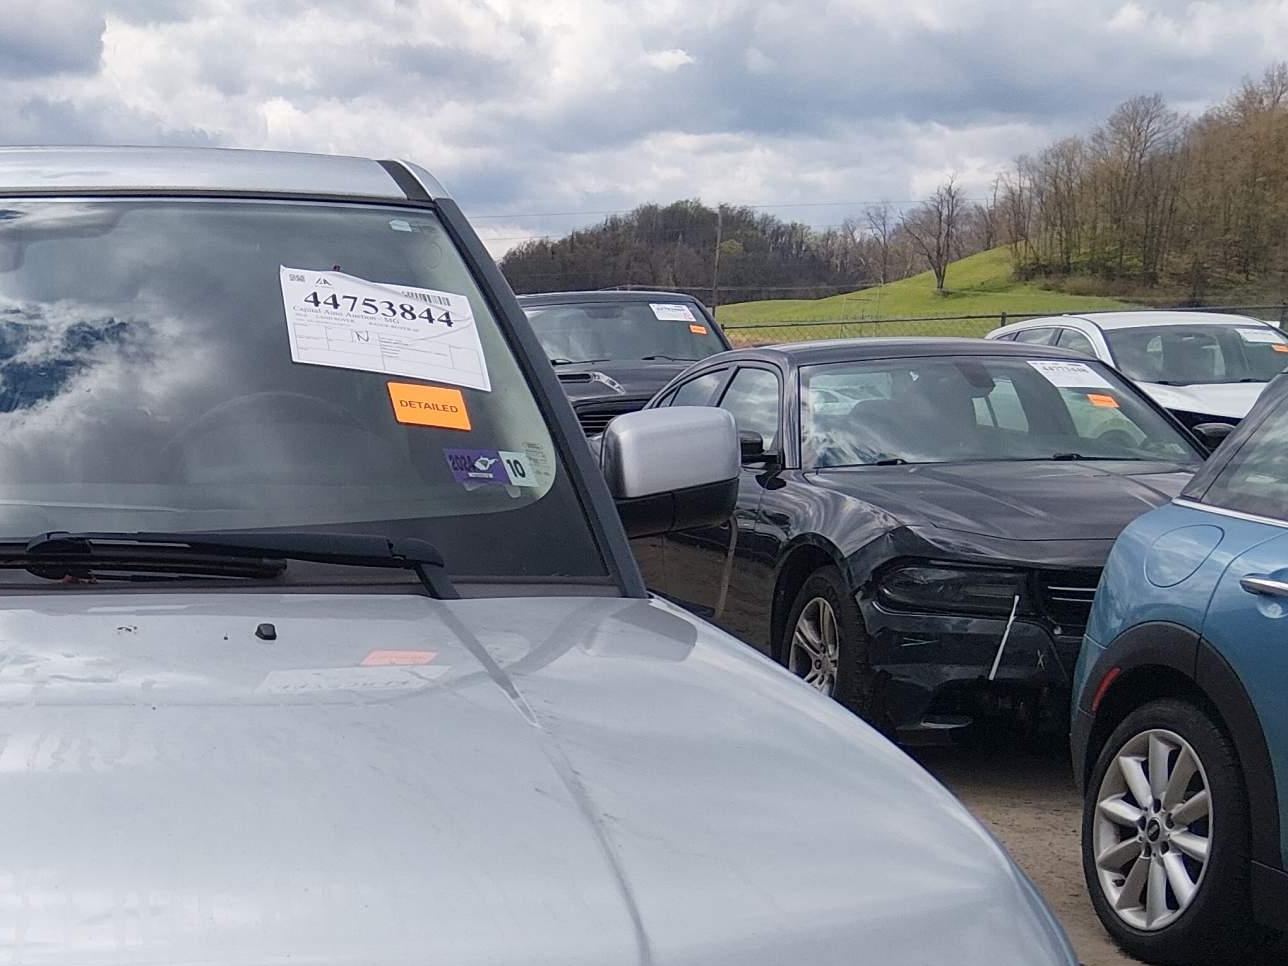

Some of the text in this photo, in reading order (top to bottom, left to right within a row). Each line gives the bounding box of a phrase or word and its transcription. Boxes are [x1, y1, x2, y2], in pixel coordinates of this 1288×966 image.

[303, 291, 455, 328] 44753844
[399, 399, 459, 414] DETAILED
[505, 458, 527, 479] 10
